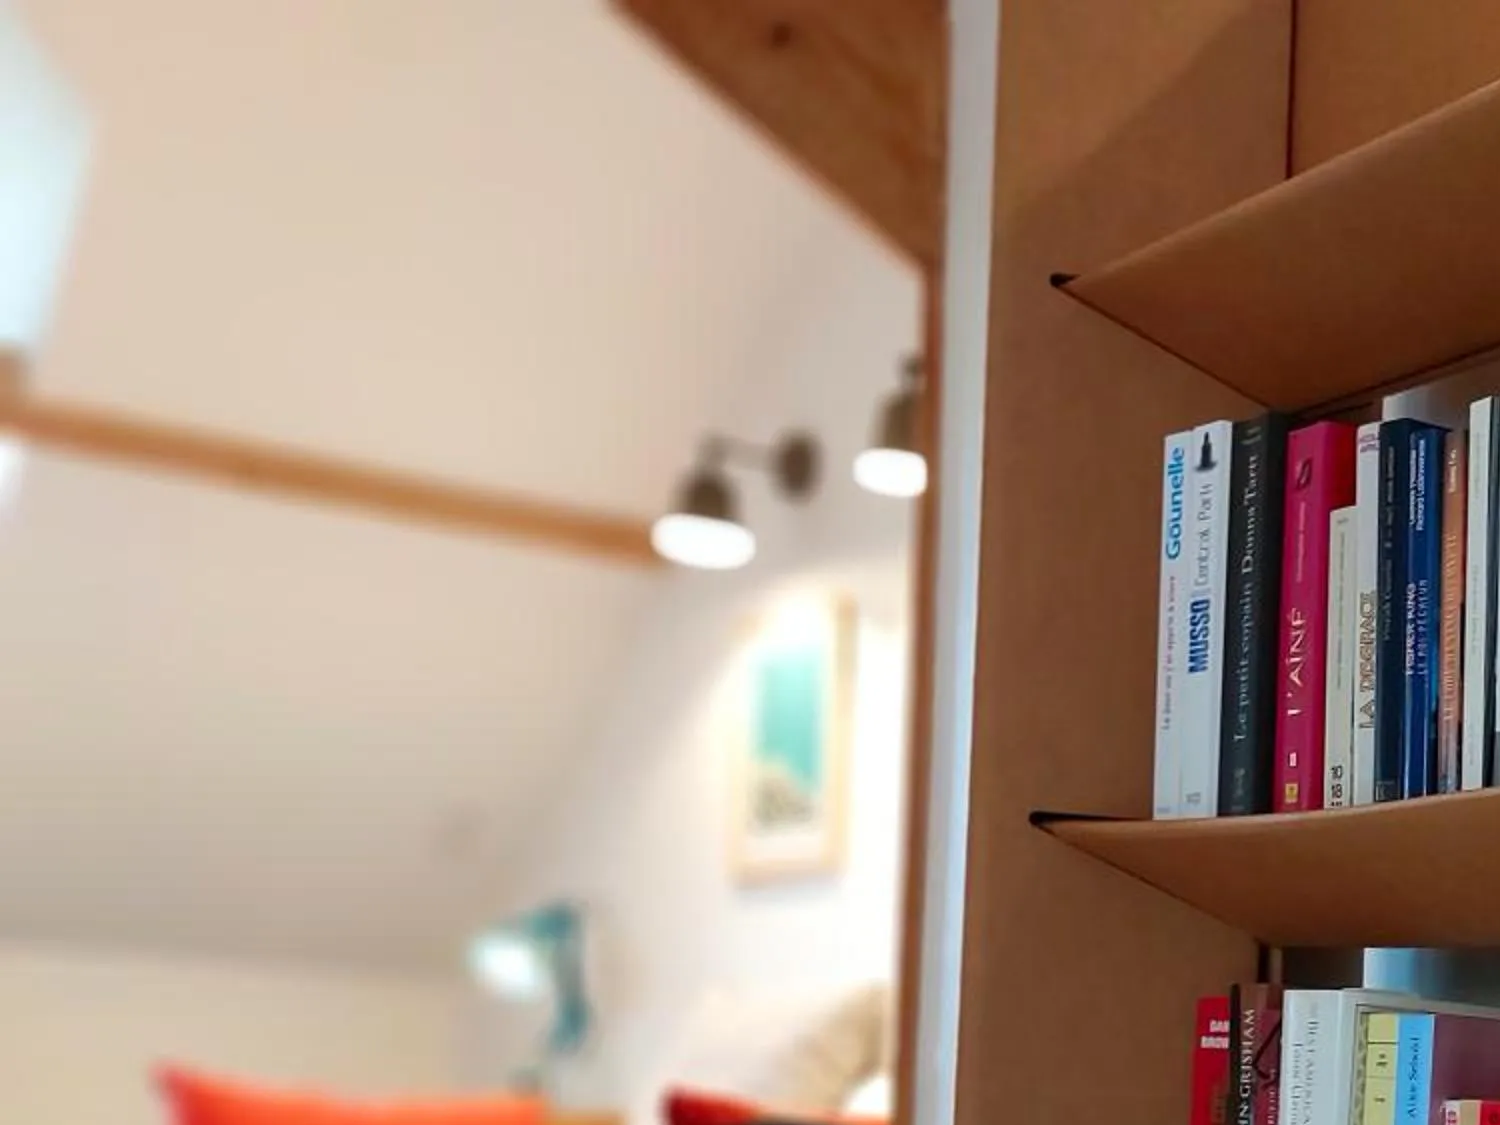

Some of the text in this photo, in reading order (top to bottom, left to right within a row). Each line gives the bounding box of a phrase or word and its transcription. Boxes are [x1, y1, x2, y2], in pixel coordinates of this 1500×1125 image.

[1165, 446, 1185, 561] Gounelle
[1195, 528, 1211, 587] Central
[1242, 506, 1257, 574] Donna
[1405, 583, 1417, 619] KING
[1188, 599, 1211, 674] MUSSO
[1236, 658, 1251, 708] petit
[1234, 714, 1247, 741] Le
[1358, 699, 1375, 729] LA
[1238, 1008, 1256, 1100] GRISHAM
